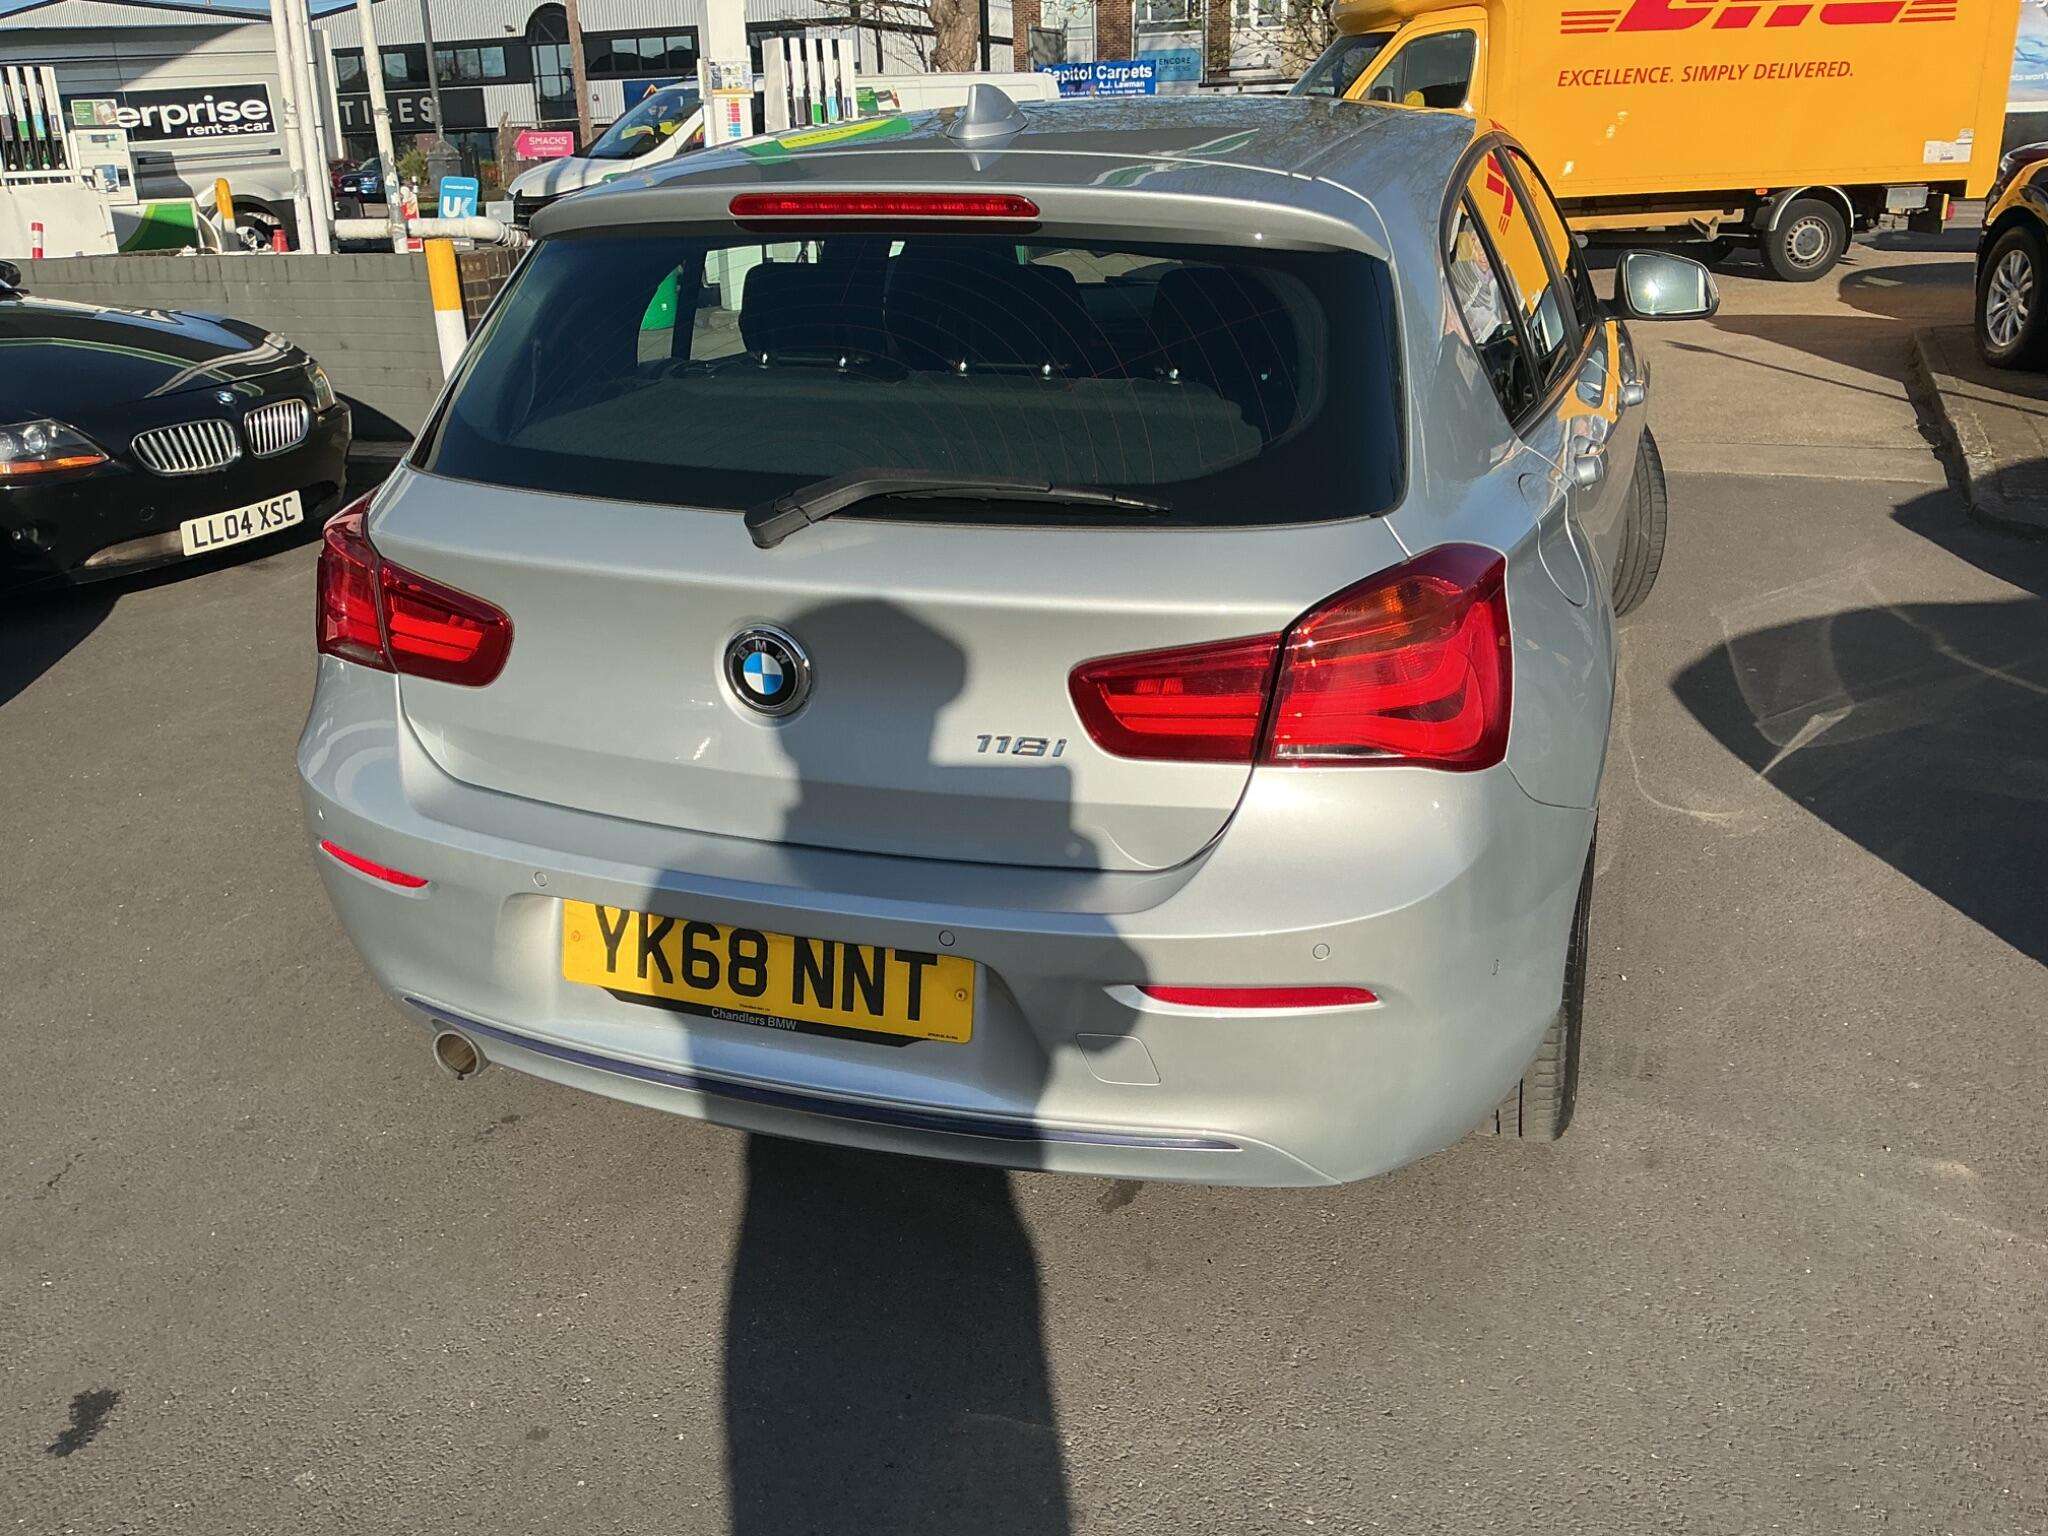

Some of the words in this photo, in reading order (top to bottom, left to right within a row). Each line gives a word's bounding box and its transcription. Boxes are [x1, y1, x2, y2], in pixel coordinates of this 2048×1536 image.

[1158, 57, 1191, 65] ENCORE
[1096, 65, 1153, 82] Carpets
[1557, 67, 1674, 87] EXCELLENCE.
[1681, 64, 1749, 83] SIMPLY
[1753, 61, 1854, 80] DELIVERED.
[339, 96, 437, 126] TIES
[187, 122, 270, 136] rent-a-car
[528, 137, 567, 146] SMACKS
[192, 510, 253, 548] LL04
[258, 497, 295, 530] XSC
[736, 640, 789, 663] BMW
[976, 734, 1067, 757] 118i
[595, 905, 769, 998] YK68
[792, 936, 938, 1022] NNT
[711, 1008, 766, 1027] Chandlers
[768, 1015, 797, 1031] BMW
